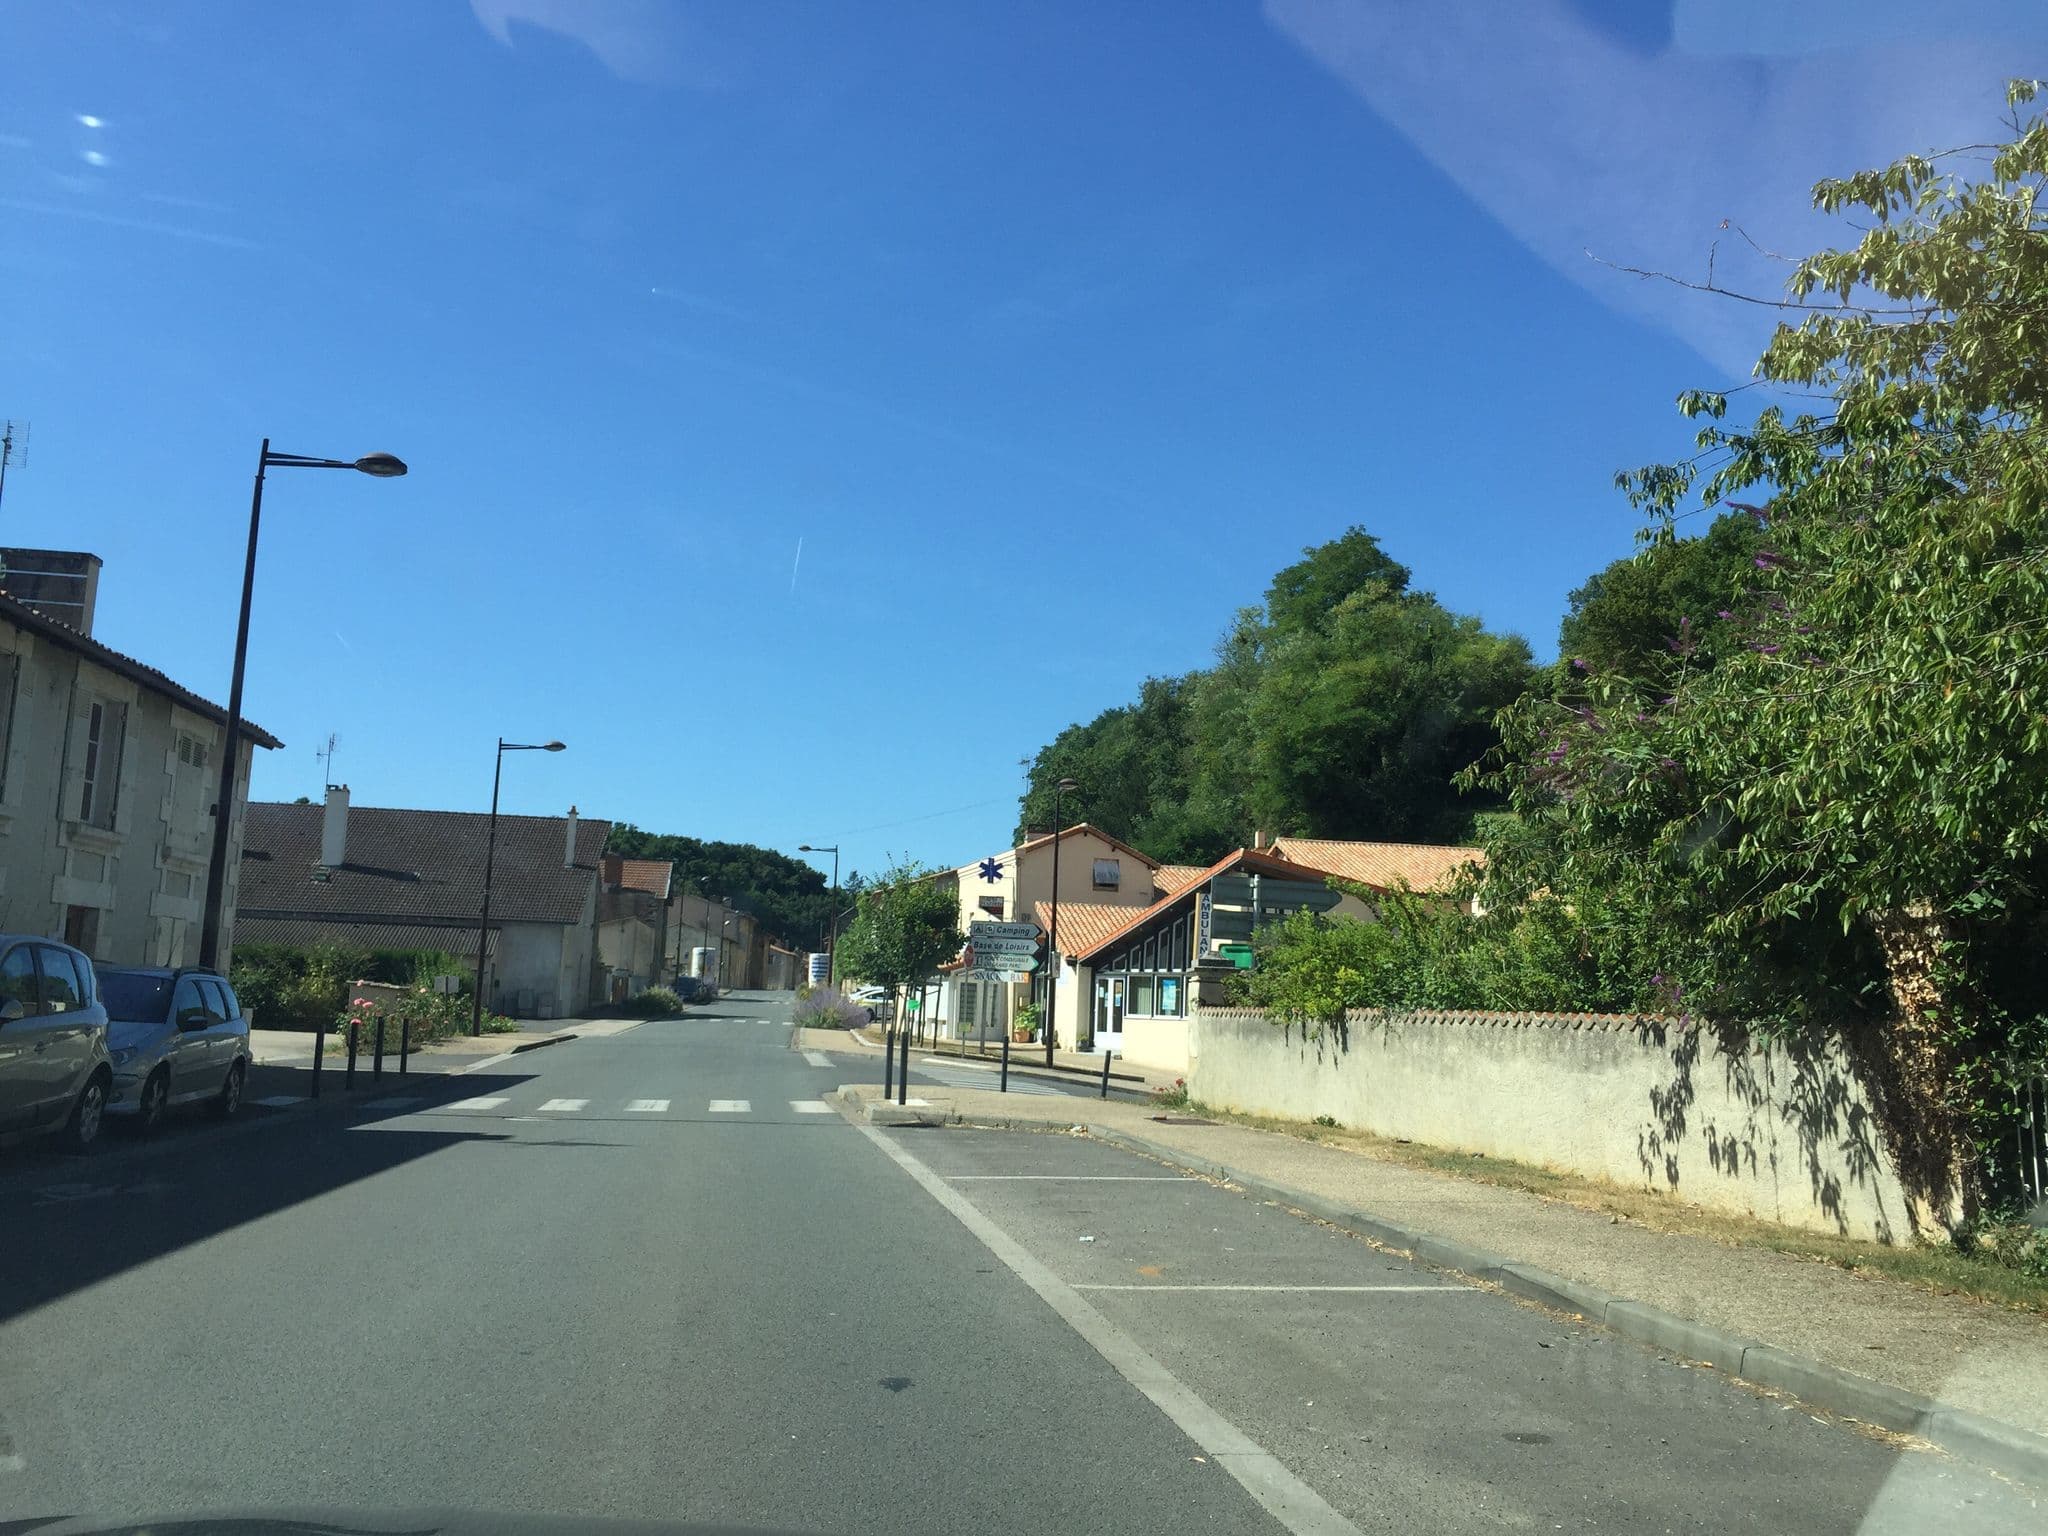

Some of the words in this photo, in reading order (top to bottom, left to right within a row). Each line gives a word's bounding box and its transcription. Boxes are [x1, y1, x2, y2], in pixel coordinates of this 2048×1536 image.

[996, 926, 1030, 937] Camping
[973, 941, 992, 949] Base
[994, 942, 1004, 950] de
[1005, 942, 1030, 951] Loisirs
[974, 971, 1002, 982] SNACK
